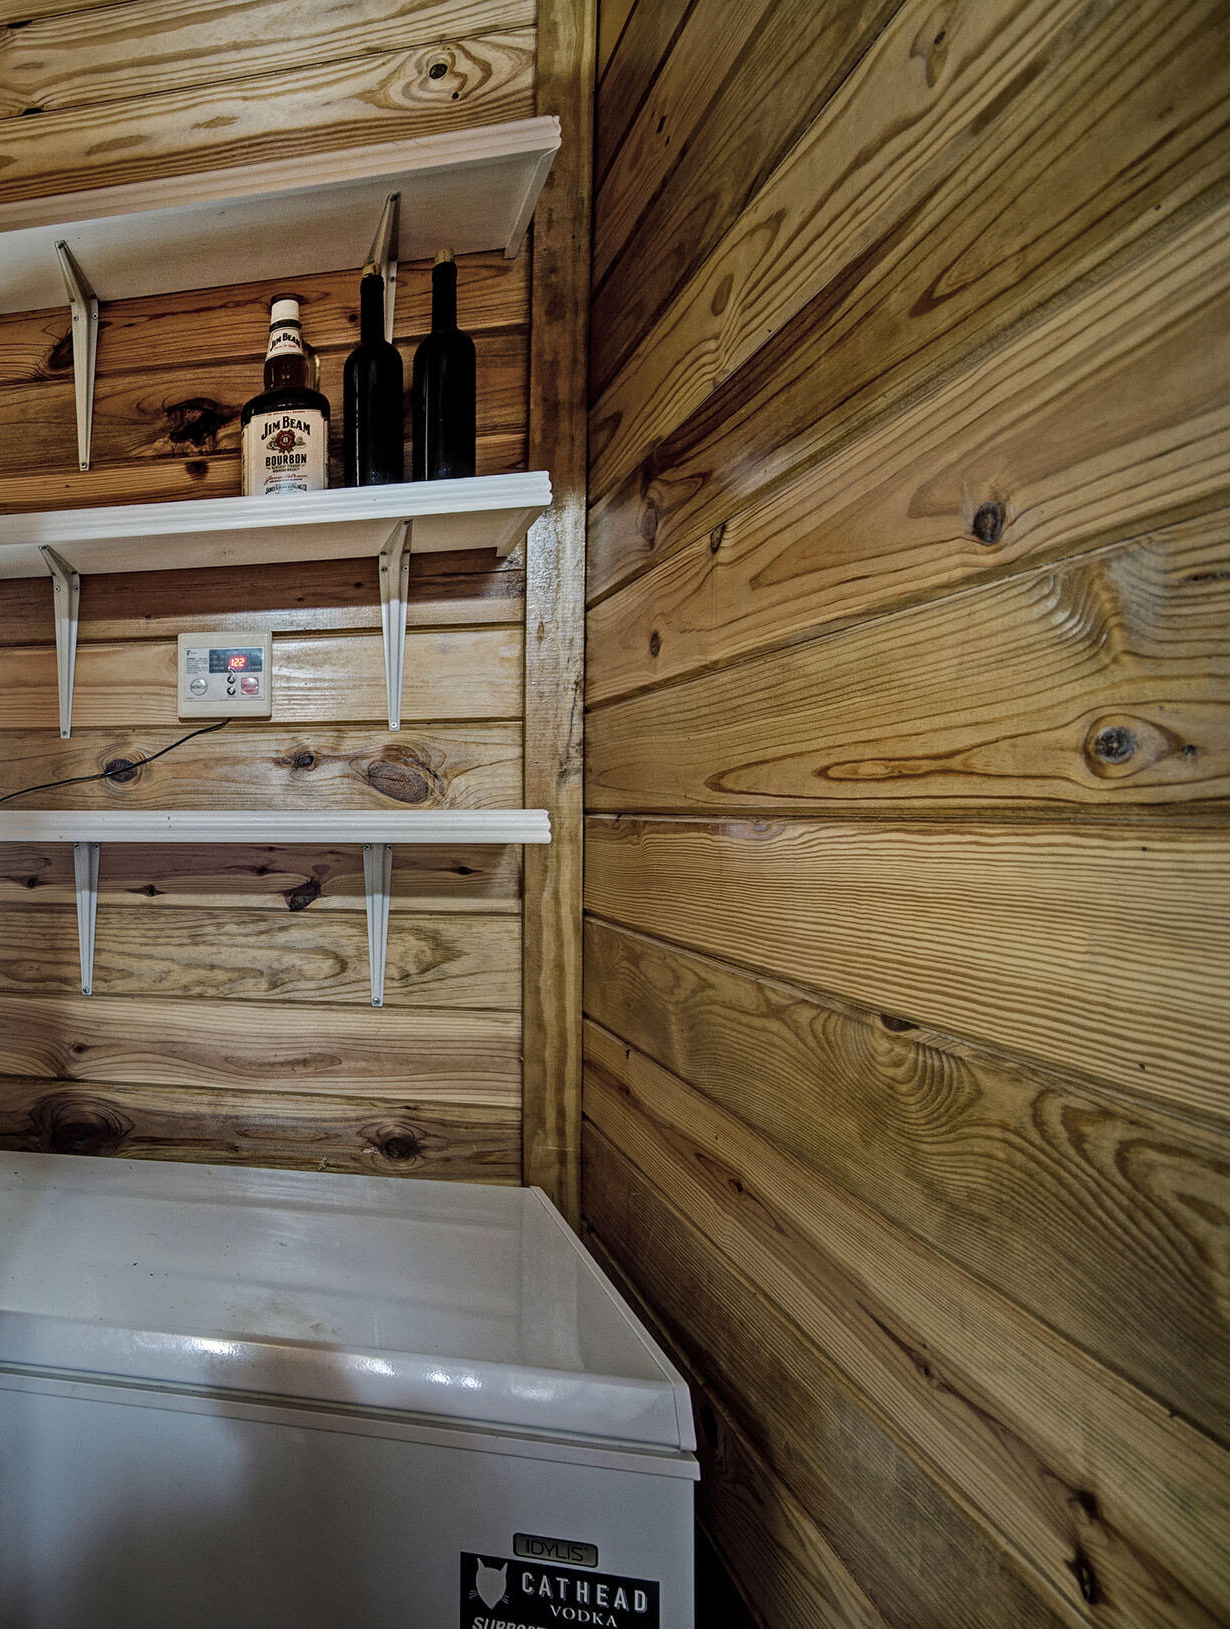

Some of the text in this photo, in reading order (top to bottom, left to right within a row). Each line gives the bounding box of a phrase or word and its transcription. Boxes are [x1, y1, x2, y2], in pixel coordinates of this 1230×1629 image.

[260, 415, 311, 441] JIM BEAM
[265, 453, 307, 467] BOURBON
[231, 658, 246, 667] 122
[525, 1540, 584, 1563] IDYLIS
[521, 1572, 648, 1614] CATHEAD
[549, 1604, 618, 1628] VODKA
